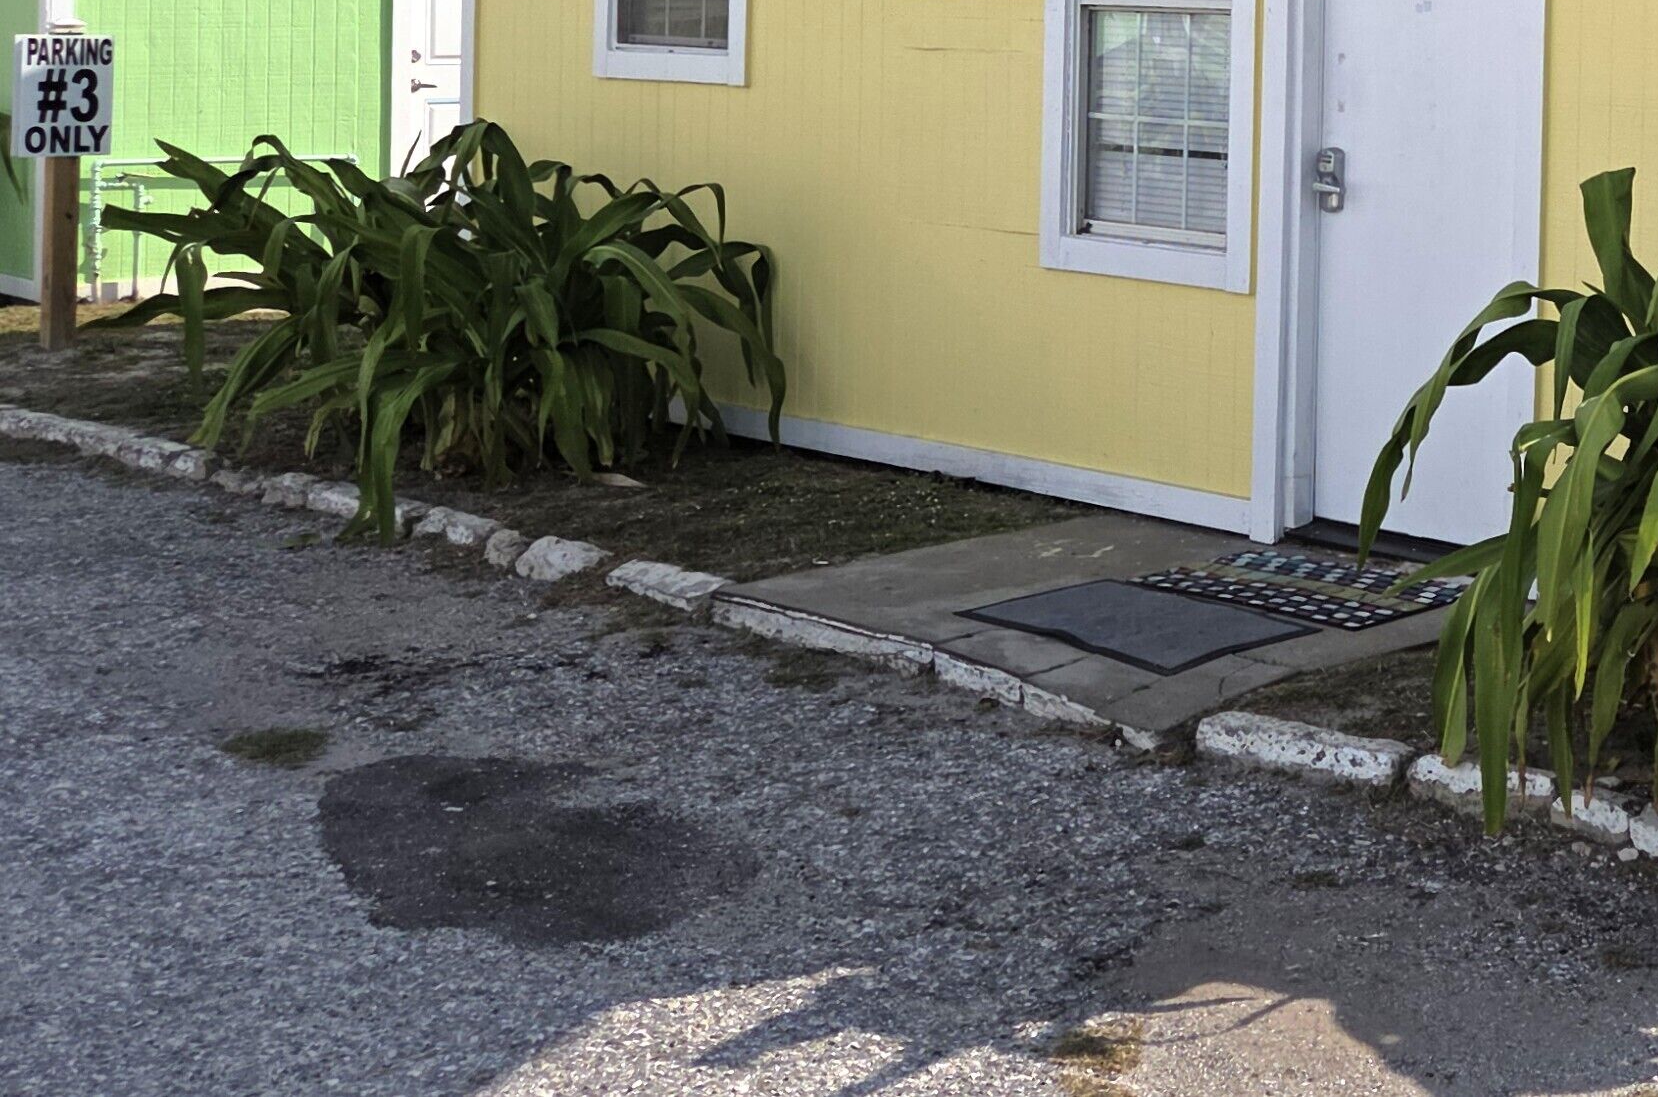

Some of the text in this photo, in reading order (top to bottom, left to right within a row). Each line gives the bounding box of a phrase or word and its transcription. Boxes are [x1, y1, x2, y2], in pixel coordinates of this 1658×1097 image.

[27, 38, 113, 65] PARKING
[37, 69, 99, 123] #3
[25, 125, 109, 153] ONLY
